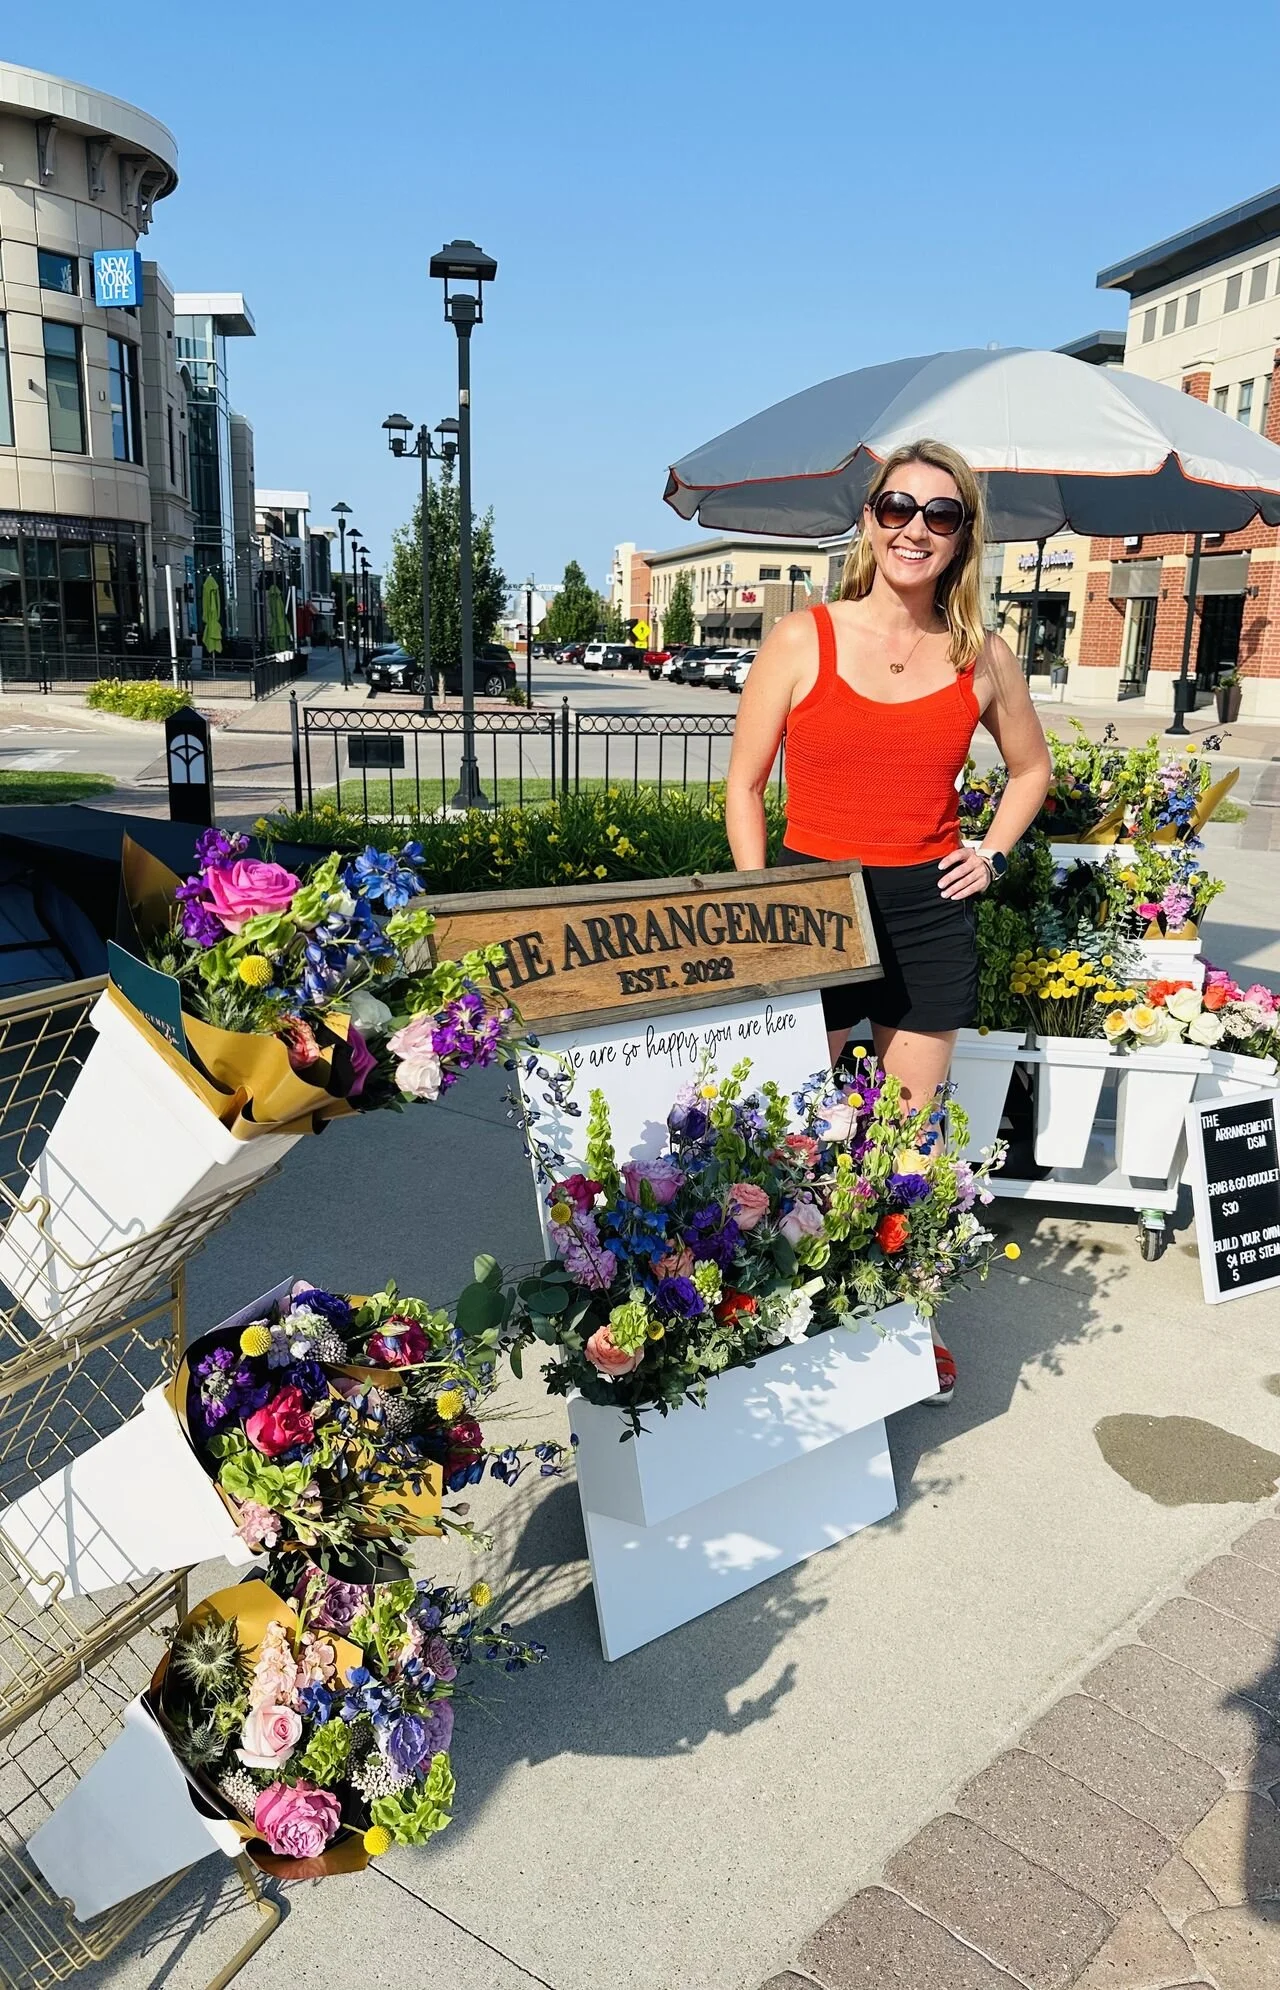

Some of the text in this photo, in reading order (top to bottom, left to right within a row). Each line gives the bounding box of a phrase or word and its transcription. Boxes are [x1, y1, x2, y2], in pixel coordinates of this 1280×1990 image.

[100, 256, 129, 272] NEW
[97, 269, 133, 286] YORK
[102, 284, 129, 300] LIFE
[484, 902, 853, 996] HE ARRANGEMENT
[617, 956, 735, 995] EST. 2022
[590, 1046, 617, 1068] are
[623, 1042, 641, 1067] so
[646, 1024, 700, 1069] happy
[704, 1025, 732, 1059] you
[738, 1019, 762, 1040] are
[765, 1004, 797, 1036] here
[1201, 1113, 1220, 1130] THE
[1215, 1117, 1274, 1142] ARRANGEMENT
[1246, 1134, 1268, 1150] DSM
[1207, 1168, 1280, 1197] GRAB & GO BOUQUET
[1221, 1200, 1240, 1217] $30
[1214, 1236, 1240, 1254] BUILD
[1239, 1230, 1262, 1248] YOUR
[1239, 1249, 1258, 1266] PER
[1232, 1268, 1241, 1282] 5
